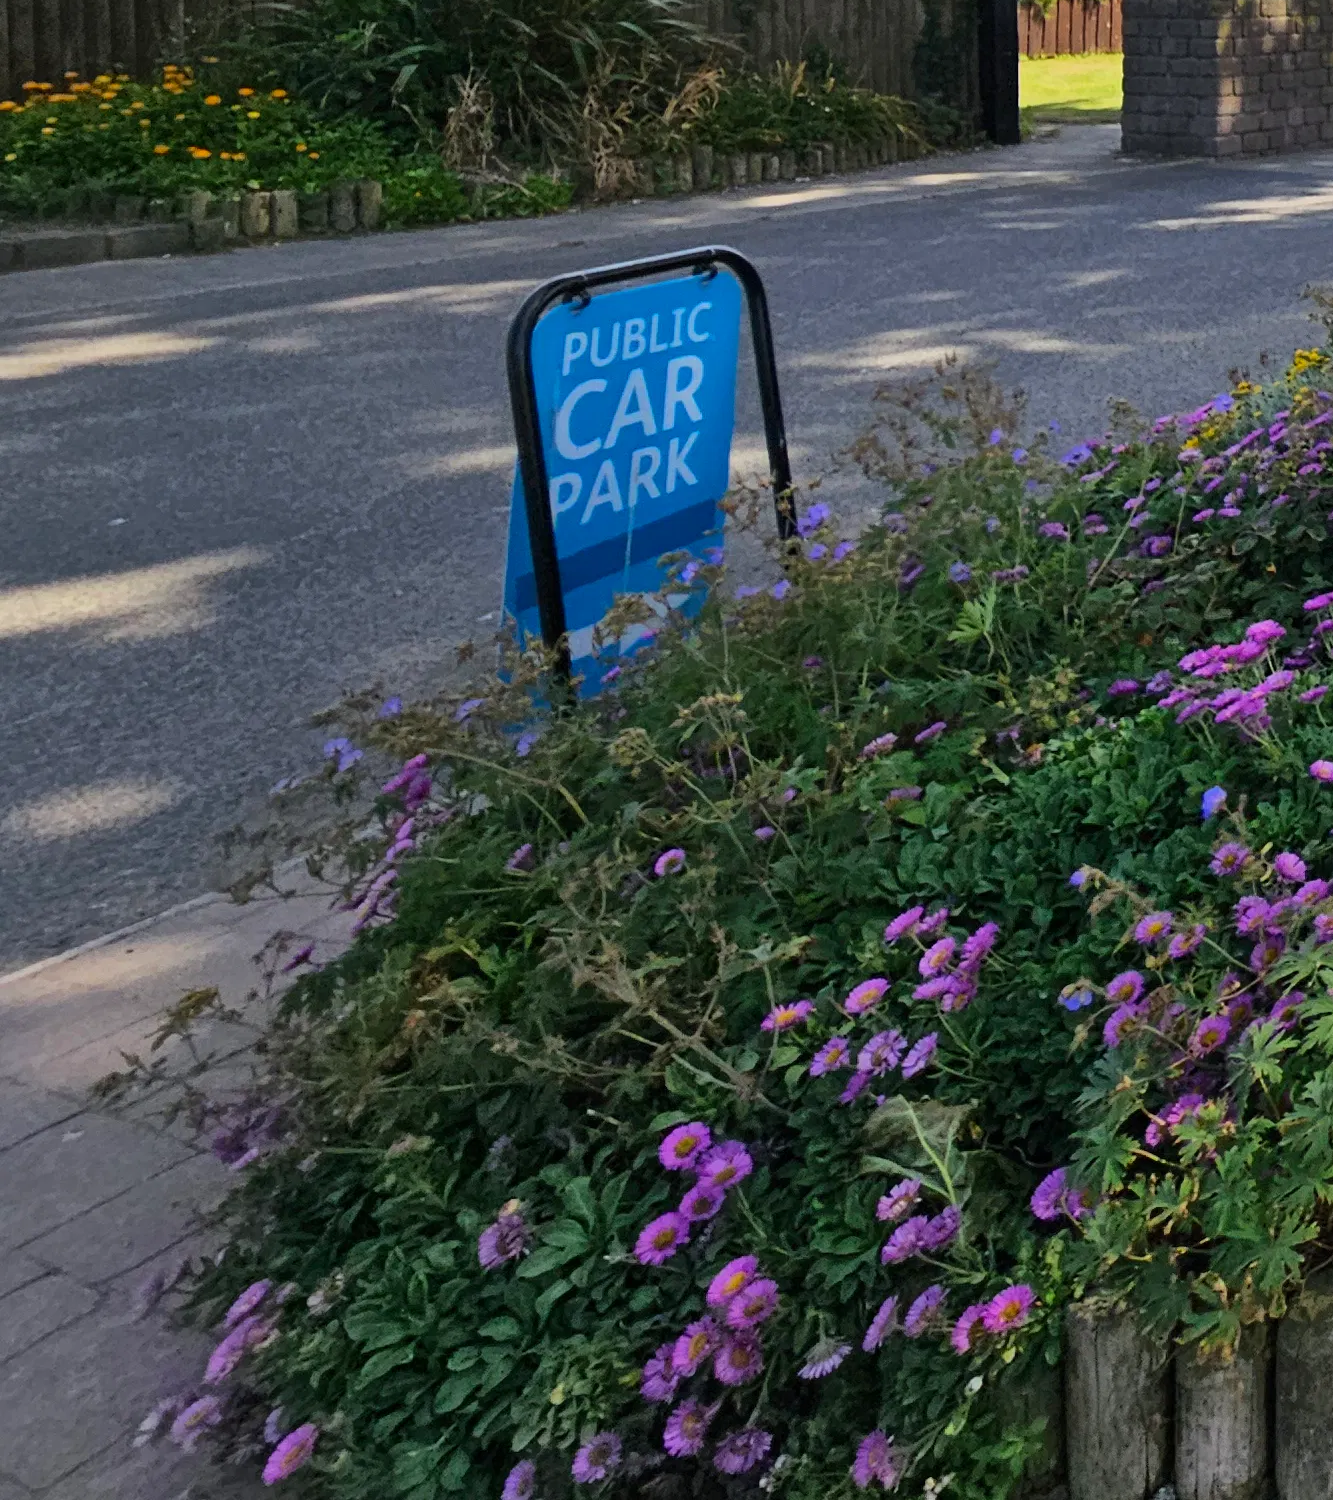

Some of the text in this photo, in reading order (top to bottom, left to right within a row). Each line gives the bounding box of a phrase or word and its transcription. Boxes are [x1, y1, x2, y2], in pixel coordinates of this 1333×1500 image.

[561, 301, 713, 376] PUBLIC
[555, 355, 705, 461] CAR
[549, 431, 700, 526] PARK
